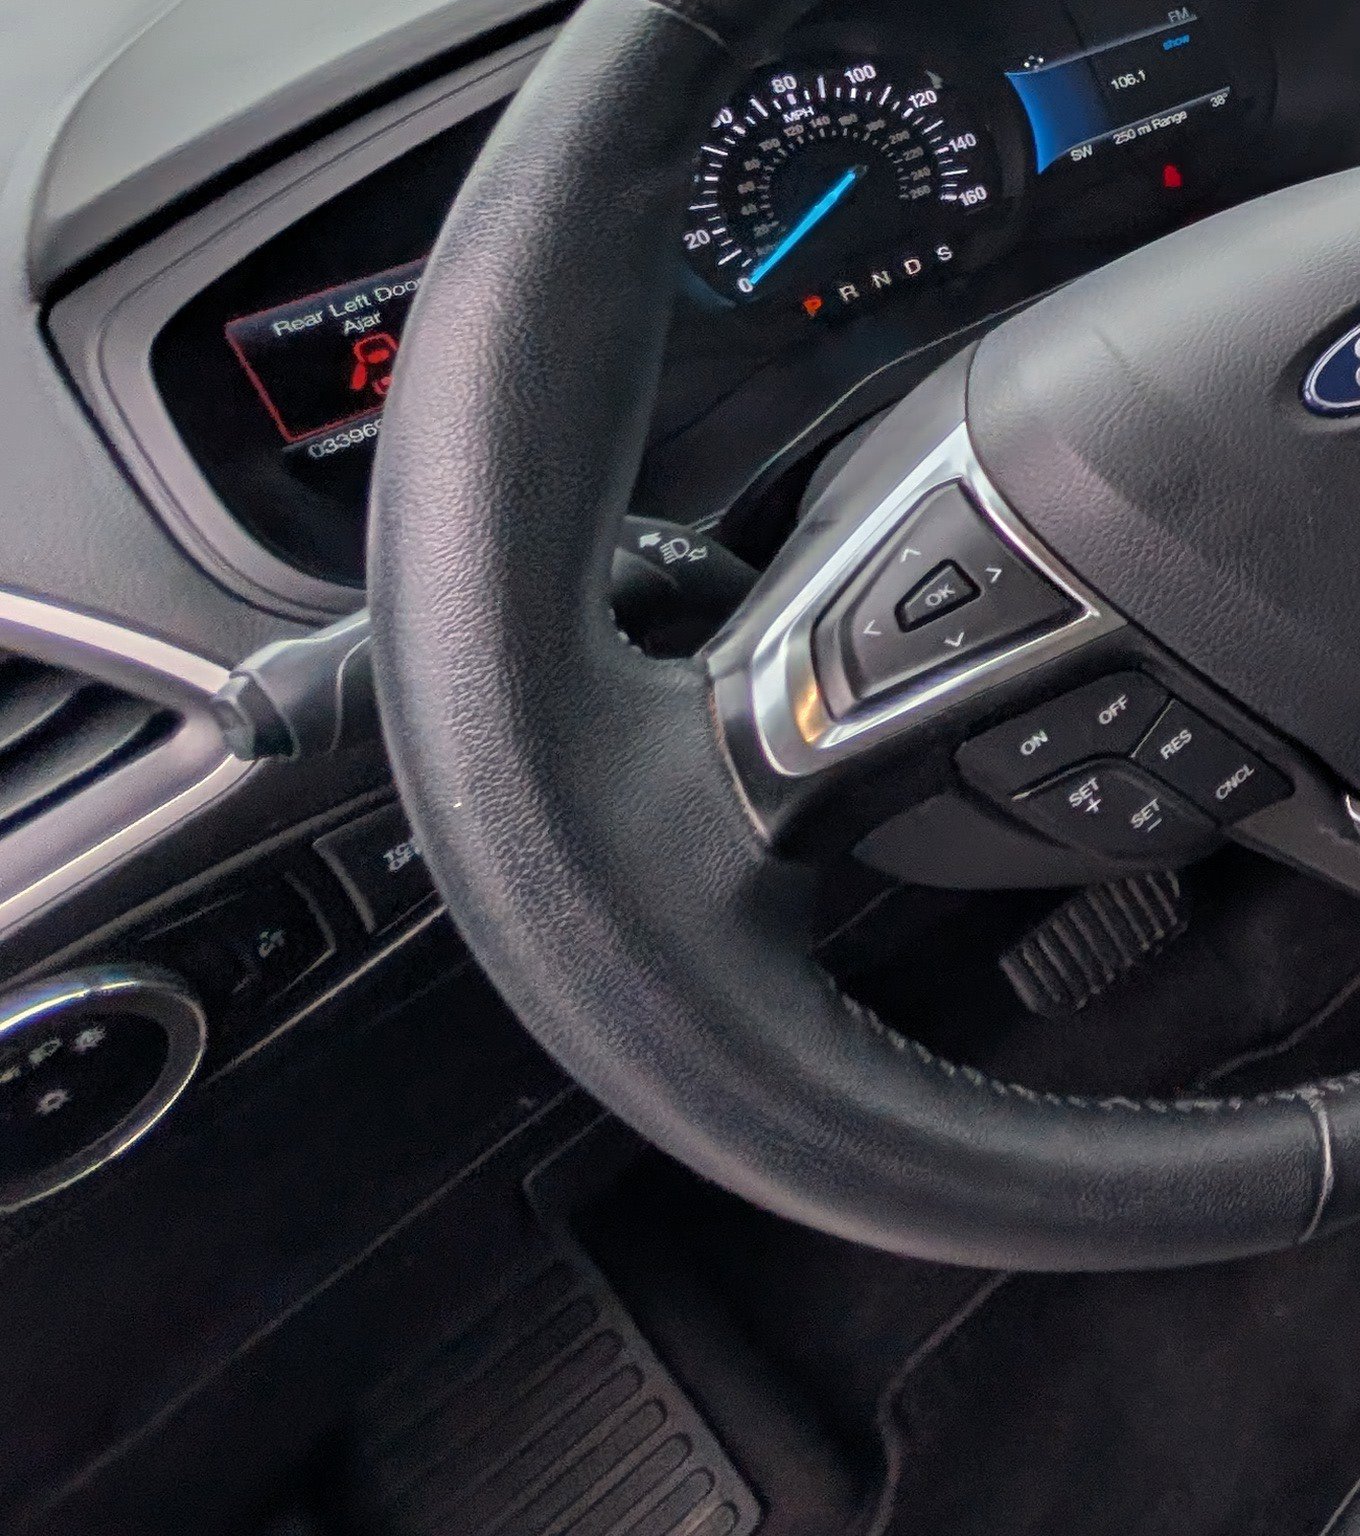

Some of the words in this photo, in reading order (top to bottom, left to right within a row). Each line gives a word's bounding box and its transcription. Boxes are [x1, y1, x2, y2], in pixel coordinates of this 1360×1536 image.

[1168, 6, 1190, 23] FM
[1162, 34, 1190, 51] show
[771, 75, 798, 95] 80
[844, 64, 877, 84] 100
[1110, 69, 1147, 91] 106.1
[908, 89, 938, 110] 120
[783, 105, 815, 123] MPH
[1112, 128, 1136, 145] 250
[1137, 122, 1152, 137] mi
[1151, 109, 1188, 131] Range
[949, 132, 977, 154] 140
[1070, 145, 1093, 162] SW
[958, 185, 987, 206] 160
[683, 228, 711, 250] 20
[839, 283, 860, 302] R
[872, 270, 892, 289] N
[904, 258, 922, 275] D
[936, 244, 954, 261] S
[737, 277, 753, 294] 0
[272, 310, 324, 337] Rear
[329, 293, 371, 318] Left
[374, 276, 421, 303] Doo
[342, 312, 382, 337] Ajar
[925, 584, 956, 608] OK
[1097, 695, 1130, 726] OFF
[1019, 728, 1050, 756] ON
[1159, 729, 1193, 760] RES
[1068, 776, 1101, 809] SET
[1214, 764, 1256, 801] CNCL
[1130, 797, 1161, 829] SET
